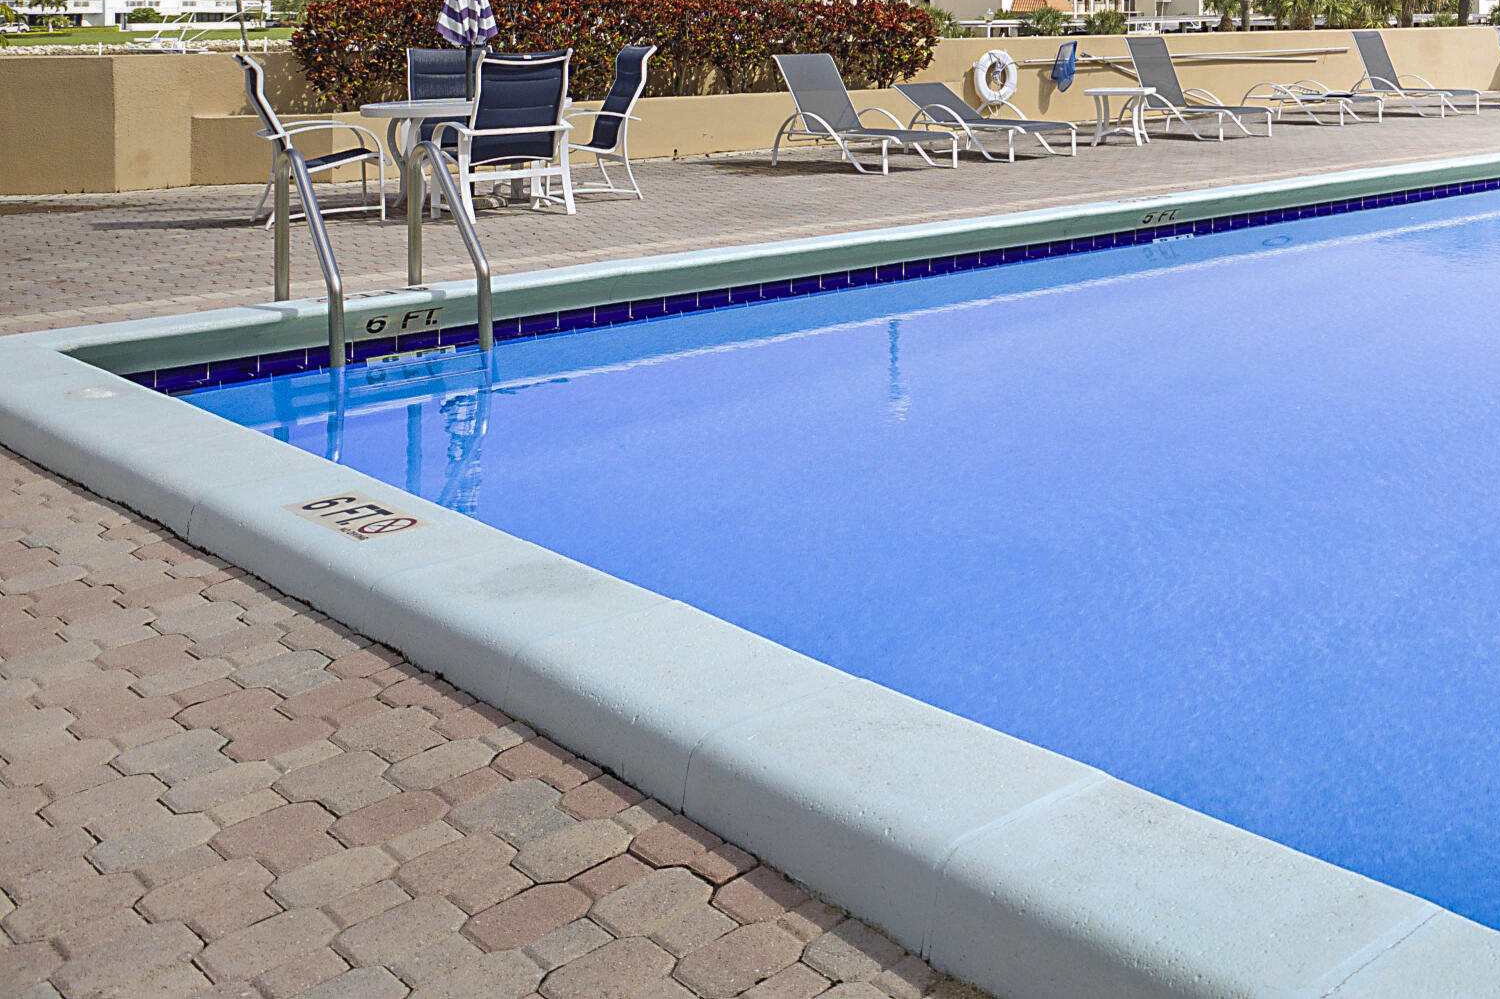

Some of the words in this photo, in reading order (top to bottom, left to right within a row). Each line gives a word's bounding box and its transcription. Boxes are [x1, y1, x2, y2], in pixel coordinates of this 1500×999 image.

[366, 315, 388, 333] 6
[401, 306, 443, 329] FT.
[302, 496, 356, 510] 6
[320, 504, 394, 526] FT.
